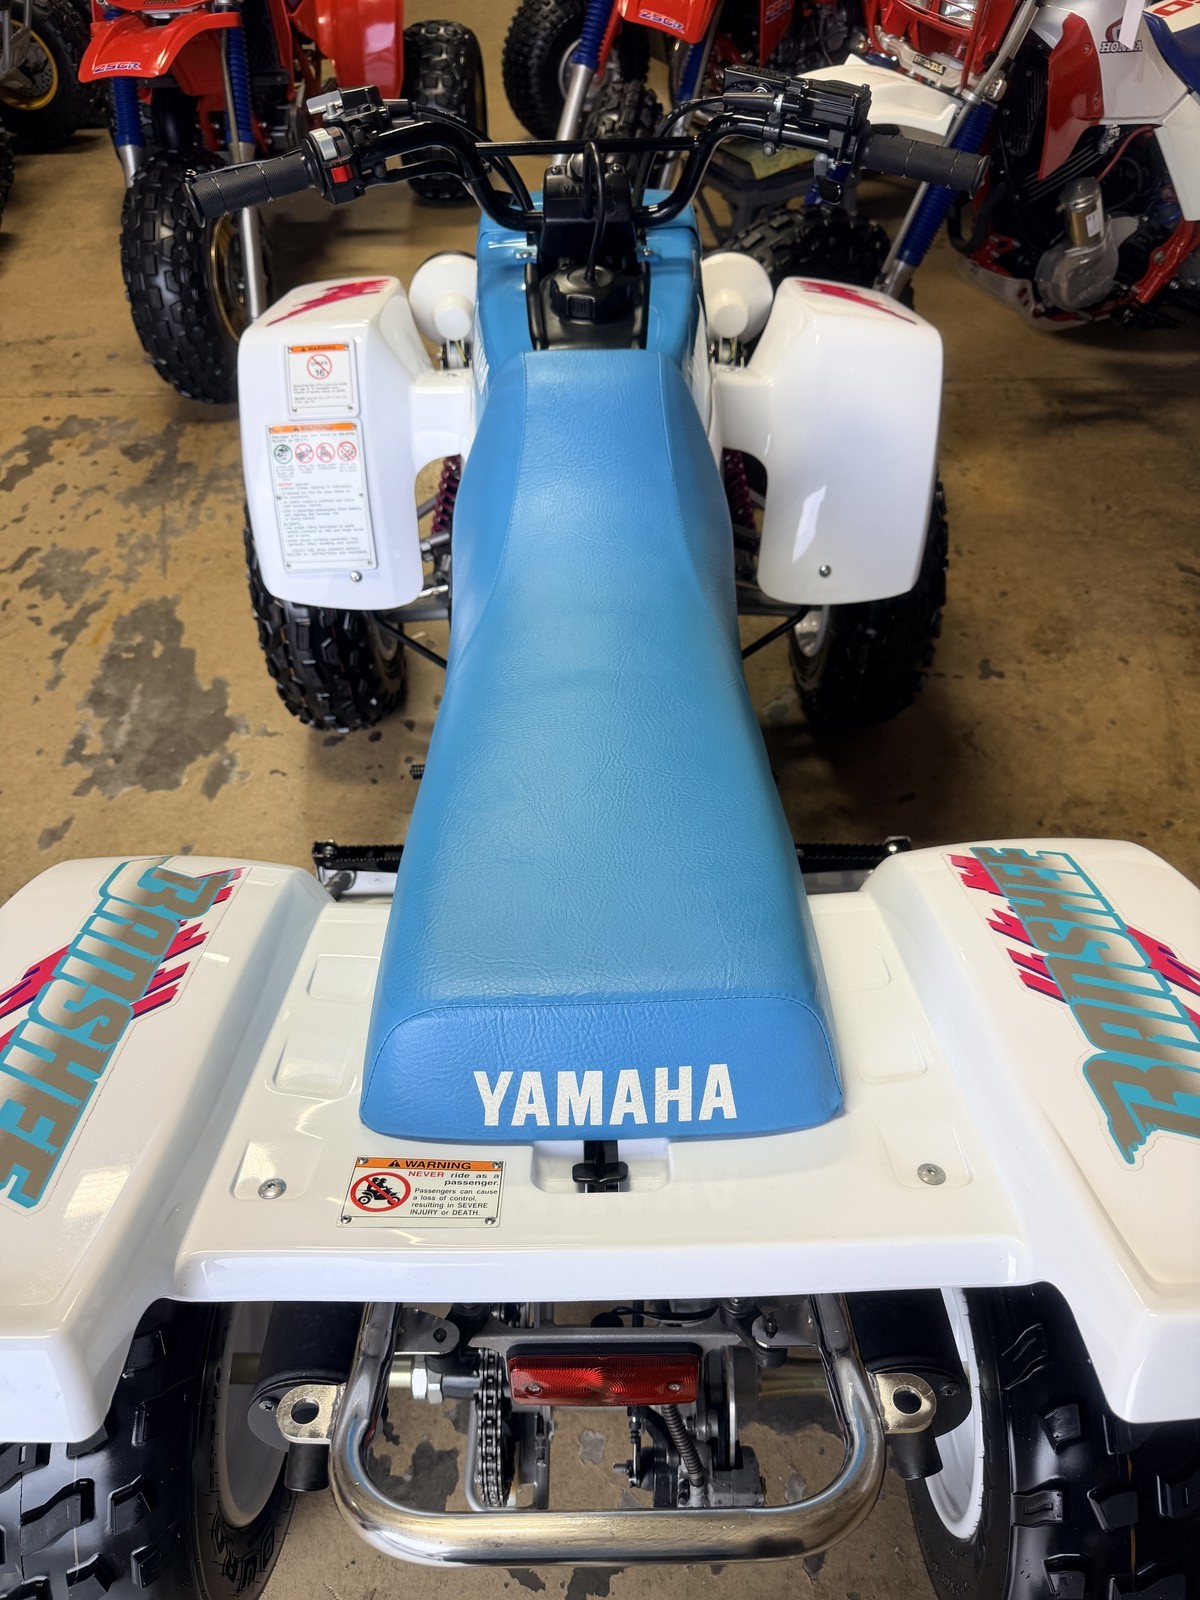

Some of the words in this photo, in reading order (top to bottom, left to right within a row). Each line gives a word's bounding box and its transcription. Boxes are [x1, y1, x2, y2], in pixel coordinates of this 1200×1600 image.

[1100, 41, 1143, 54] HONA
[473, 1063, 738, 1126] YAMAHA
[405, 1160, 472, 1170] WARNING
[414, 1187, 457, 1195] Passengers
[411, 1201, 444, 1209] resulting
